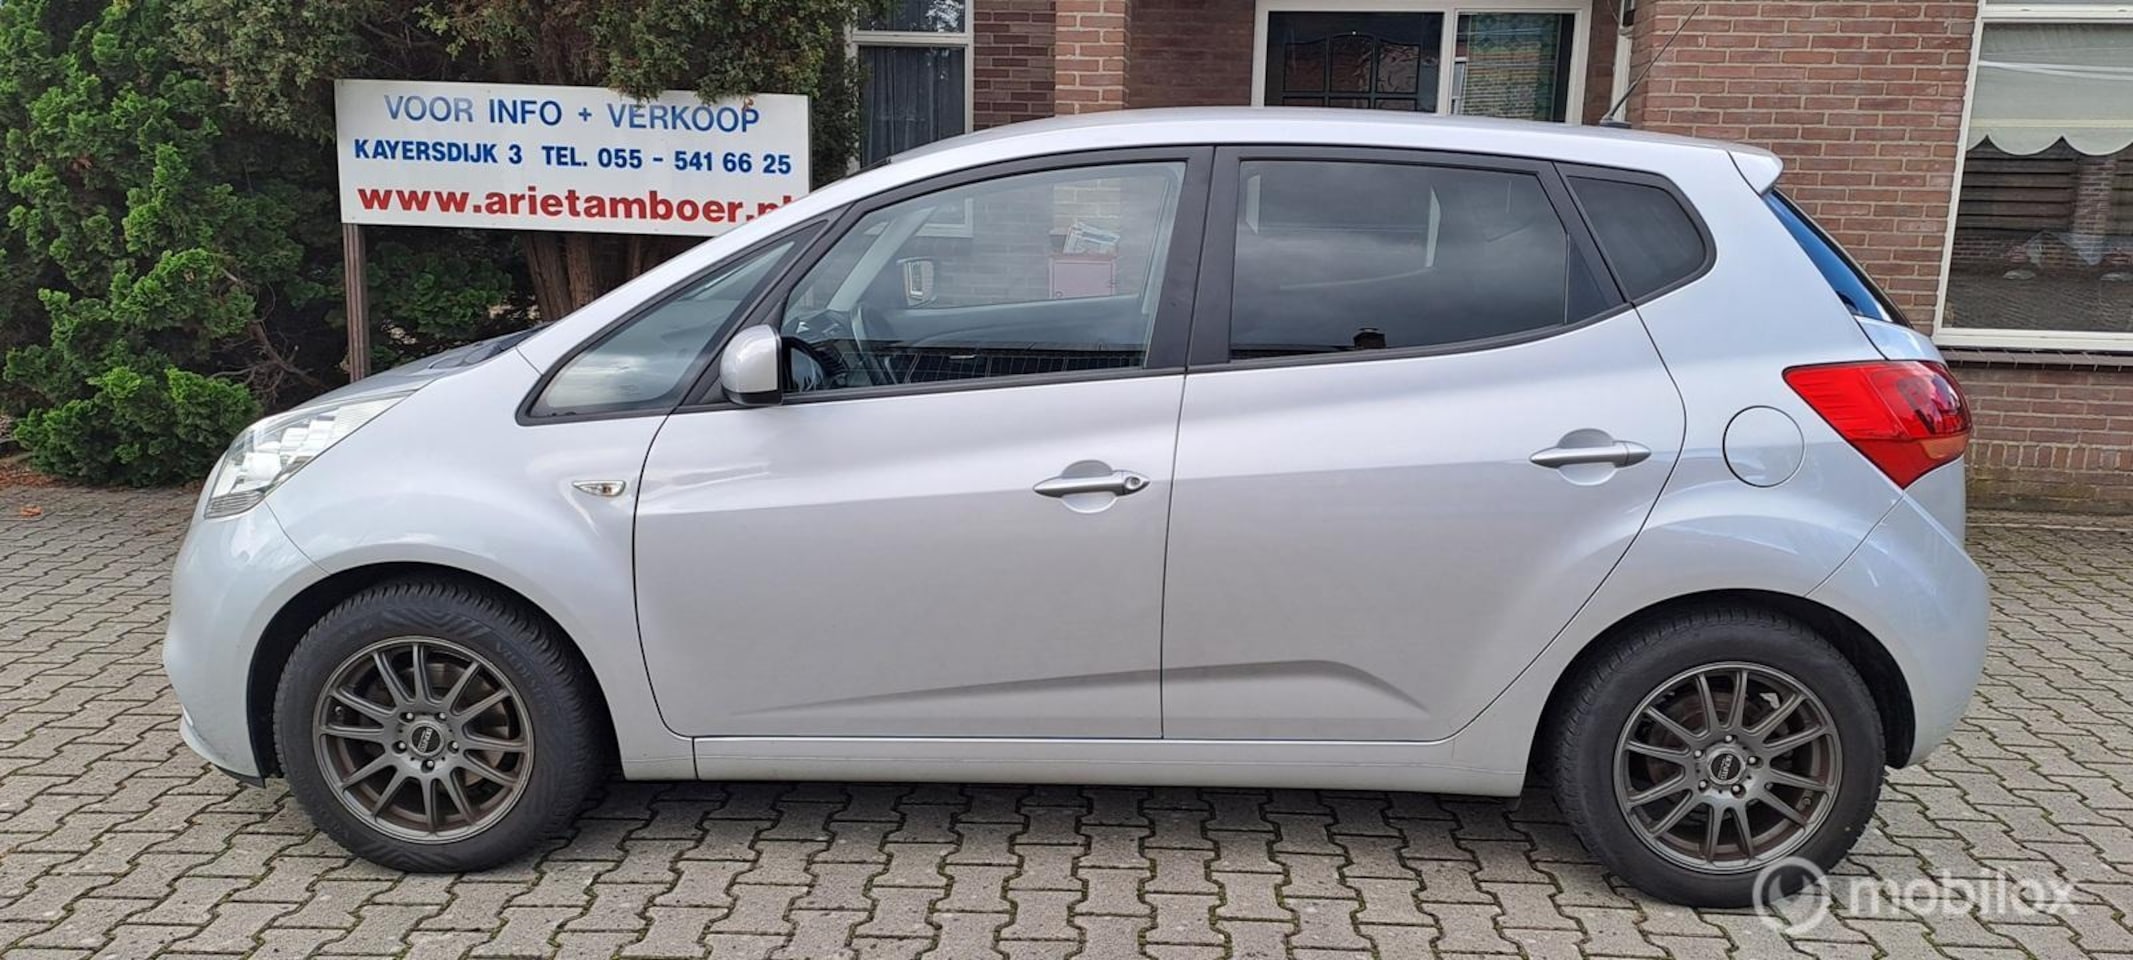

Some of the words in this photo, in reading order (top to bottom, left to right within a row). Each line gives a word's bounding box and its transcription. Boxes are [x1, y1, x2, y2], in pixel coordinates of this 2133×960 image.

[384, 95, 474, 123] VOOR
[488, 99, 562, 126] INFO
[607, 103, 760, 133] VERKOOP
[354, 138, 498, 164] KAYERSDIJK
[508, 143, 523, 165] 3
[542, 144, 588, 168] TEL.
[598, 147, 643, 169] 055
[674, 150, 714, 172] 541
[722, 151, 753, 174] 66
[763, 153, 792, 175] 25
